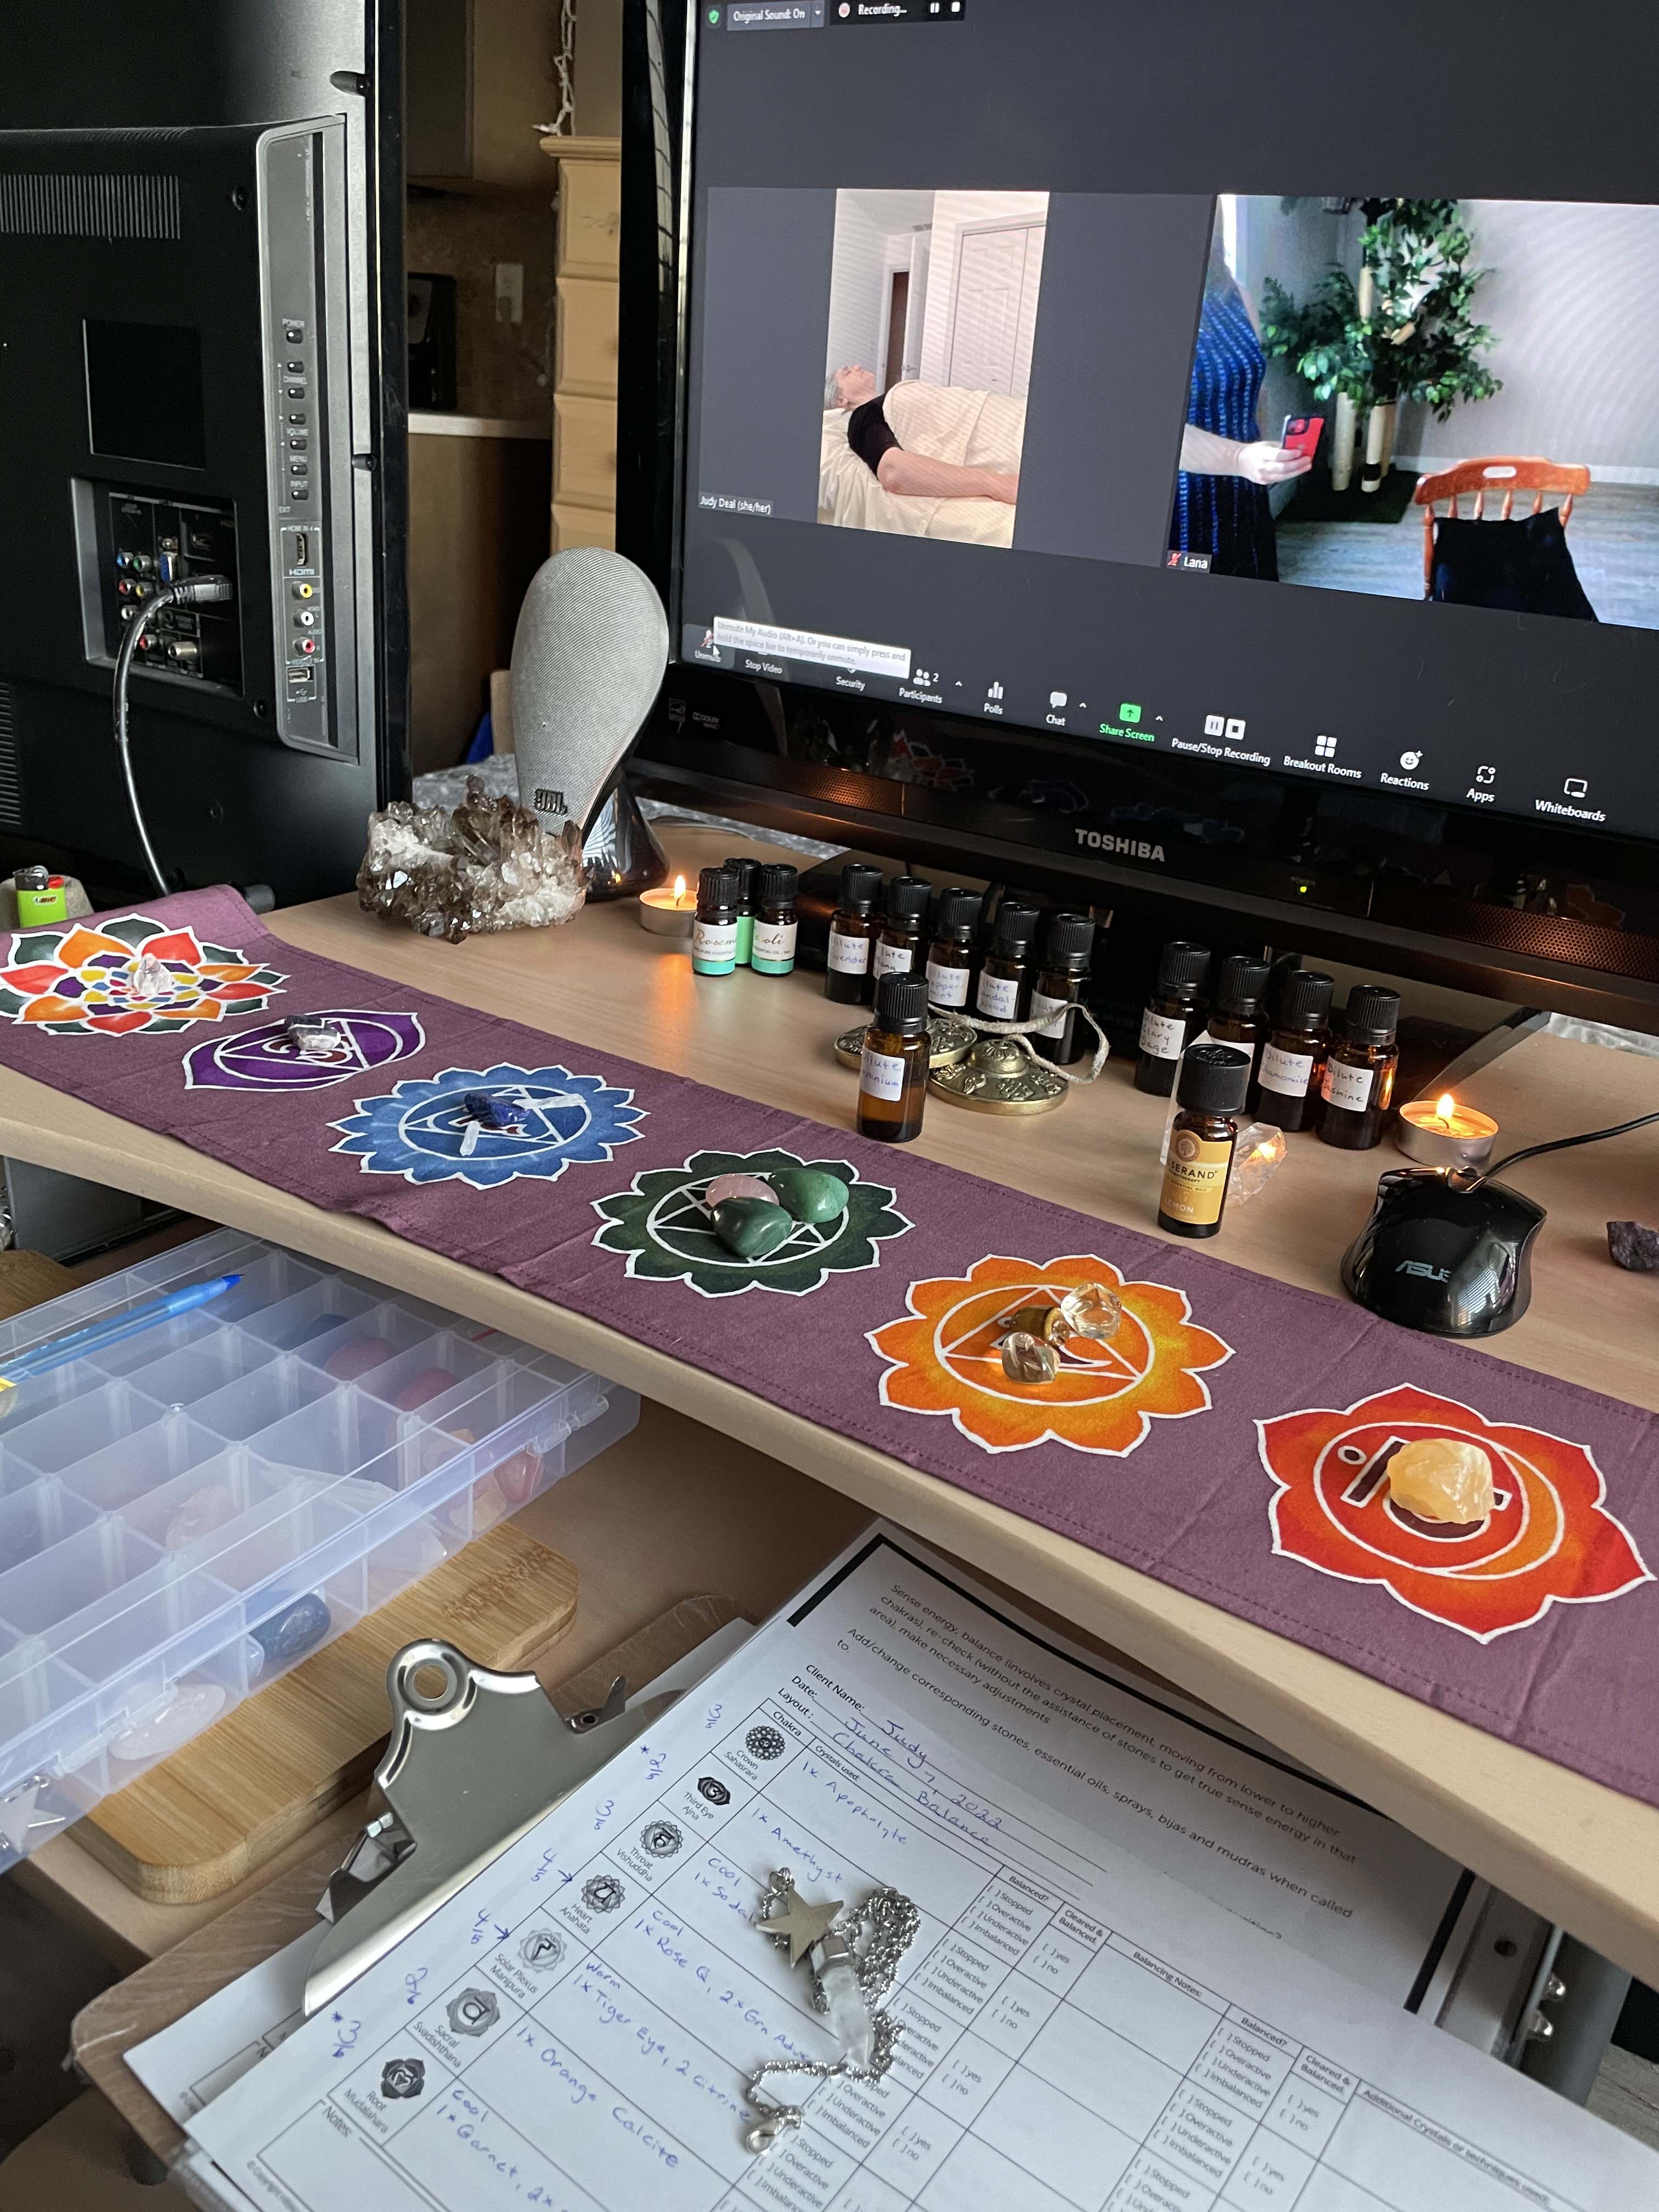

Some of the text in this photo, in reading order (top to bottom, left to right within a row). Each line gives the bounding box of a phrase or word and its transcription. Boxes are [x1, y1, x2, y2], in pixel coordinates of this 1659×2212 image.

[733, 10, 805, 23] Original Sound: On
[700, 496, 771, 515] Judy Deal (she/her)
[1184, 556, 1207, 569] Lana
[717, 620, 743, 632] Unmute
[745, 624, 756, 637] My
[758, 627, 778, 640] Audio
[808, 636, 816, 646] Or
[817, 640, 831, 651] you
[832, 642, 845, 651] can
[847, 645, 870, 660] simply
[871, 650, 890, 662] press
[891, 652, 905, 662] and
[717, 633, 856, 665] hold the space bar to temporarily unmute.
[745, 659, 782, 675] Stop Video
[933, 673, 939, 682] 2
[836, 676, 866, 692] Security
[899, 686, 943, 704] Participants
[984, 703, 1003, 716] Polls
[1046, 714, 1065, 727] Chat
[1099, 724, 1155, 743] Share Screen
[1171, 738, 1271, 767] Pause/Stop Recording
[1283, 755, 1362, 779] Breakout Rooms
[1380, 772, 1430, 791] Reactions
[1466, 788, 1495, 803] Apps
[1535, 799, 1606, 822] Whiteboards
[1075, 828, 1165, 862] TOSHIBA
[1141, 1037, 1169, 1054] Sage
[837, 1638, 851, 1654] to.
[869, 1606, 1052, 1725] area), make necessary adjustments
[791, 1675, 818, 1700] Date:
[805, 1664, 865, 1713] Client Name:
[772, 1710, 802, 1737] Chakra
[891, 1584, 1341, 1837] Sense energy, balance (involves crystal placement, moving from lower to higher
[881, 1595, 1357, 1865] chakras), re-check (without the assistance of stones to get true sense energy in that
[881, 1719, 929, 1770] Judy
[724, 1751, 758, 1782] Sahasrara
[736, 1749, 759, 1770] Crown
[815, 1745, 861, 1782] Crystals used:
[844, 1717, 895, 1759] June
[950, 1794, 1004, 1830] 2022
[847, 1627, 1354, 1918] Add/change corresponding stones, essential oils, sprays, bijas and mudras when called
[832, 1731, 991, 1844] Chakra Balance
[682, 1804, 700, 1821] Ajna
[684, 1791, 714, 1820] Third Eye
[630, 1846, 653, 1870] Throat
[752, 1808, 843, 1883] 1x Amethyst
[617, 1848, 653, 1883] Vishuddha
[1008, 1875, 1049, 1902] Balanced?
[571, 1903, 593, 1924] Heart
[991, 1903, 1032, 1932] Overactive
[1001, 1893, 1033, 1916] Stopped
[560, 1906, 591, 1935] Anahata
[984, 1914, 1029, 1946] Underactive
[1064, 1910, 1103, 1937] Cleared &
[657, 1937, 688, 1968] Rose
[974, 1924, 1020, 1956] Imbalanced
[1047, 1962, 1059, 1975] no
[1055, 1951, 1071, 1965] yes
[489, 1964, 526, 1999] Manipura
[495, 1953, 538, 1995] Solar Plexus
[1132, 1950, 1203, 1998] Balancing Notes:
[413, 2021, 462, 2068] Svadishthana
[434, 2024, 461, 2049] Sacral
[597, 1990, 632, 2024] Tiger
[675, 2059, 690, 2075] 2
[365, 2090, 388, 2113] Root
[541, 2047, 596, 2104] Orange
[612, 2106, 680, 2168] Calcite
[322, 2105, 353, 2138] Notes
